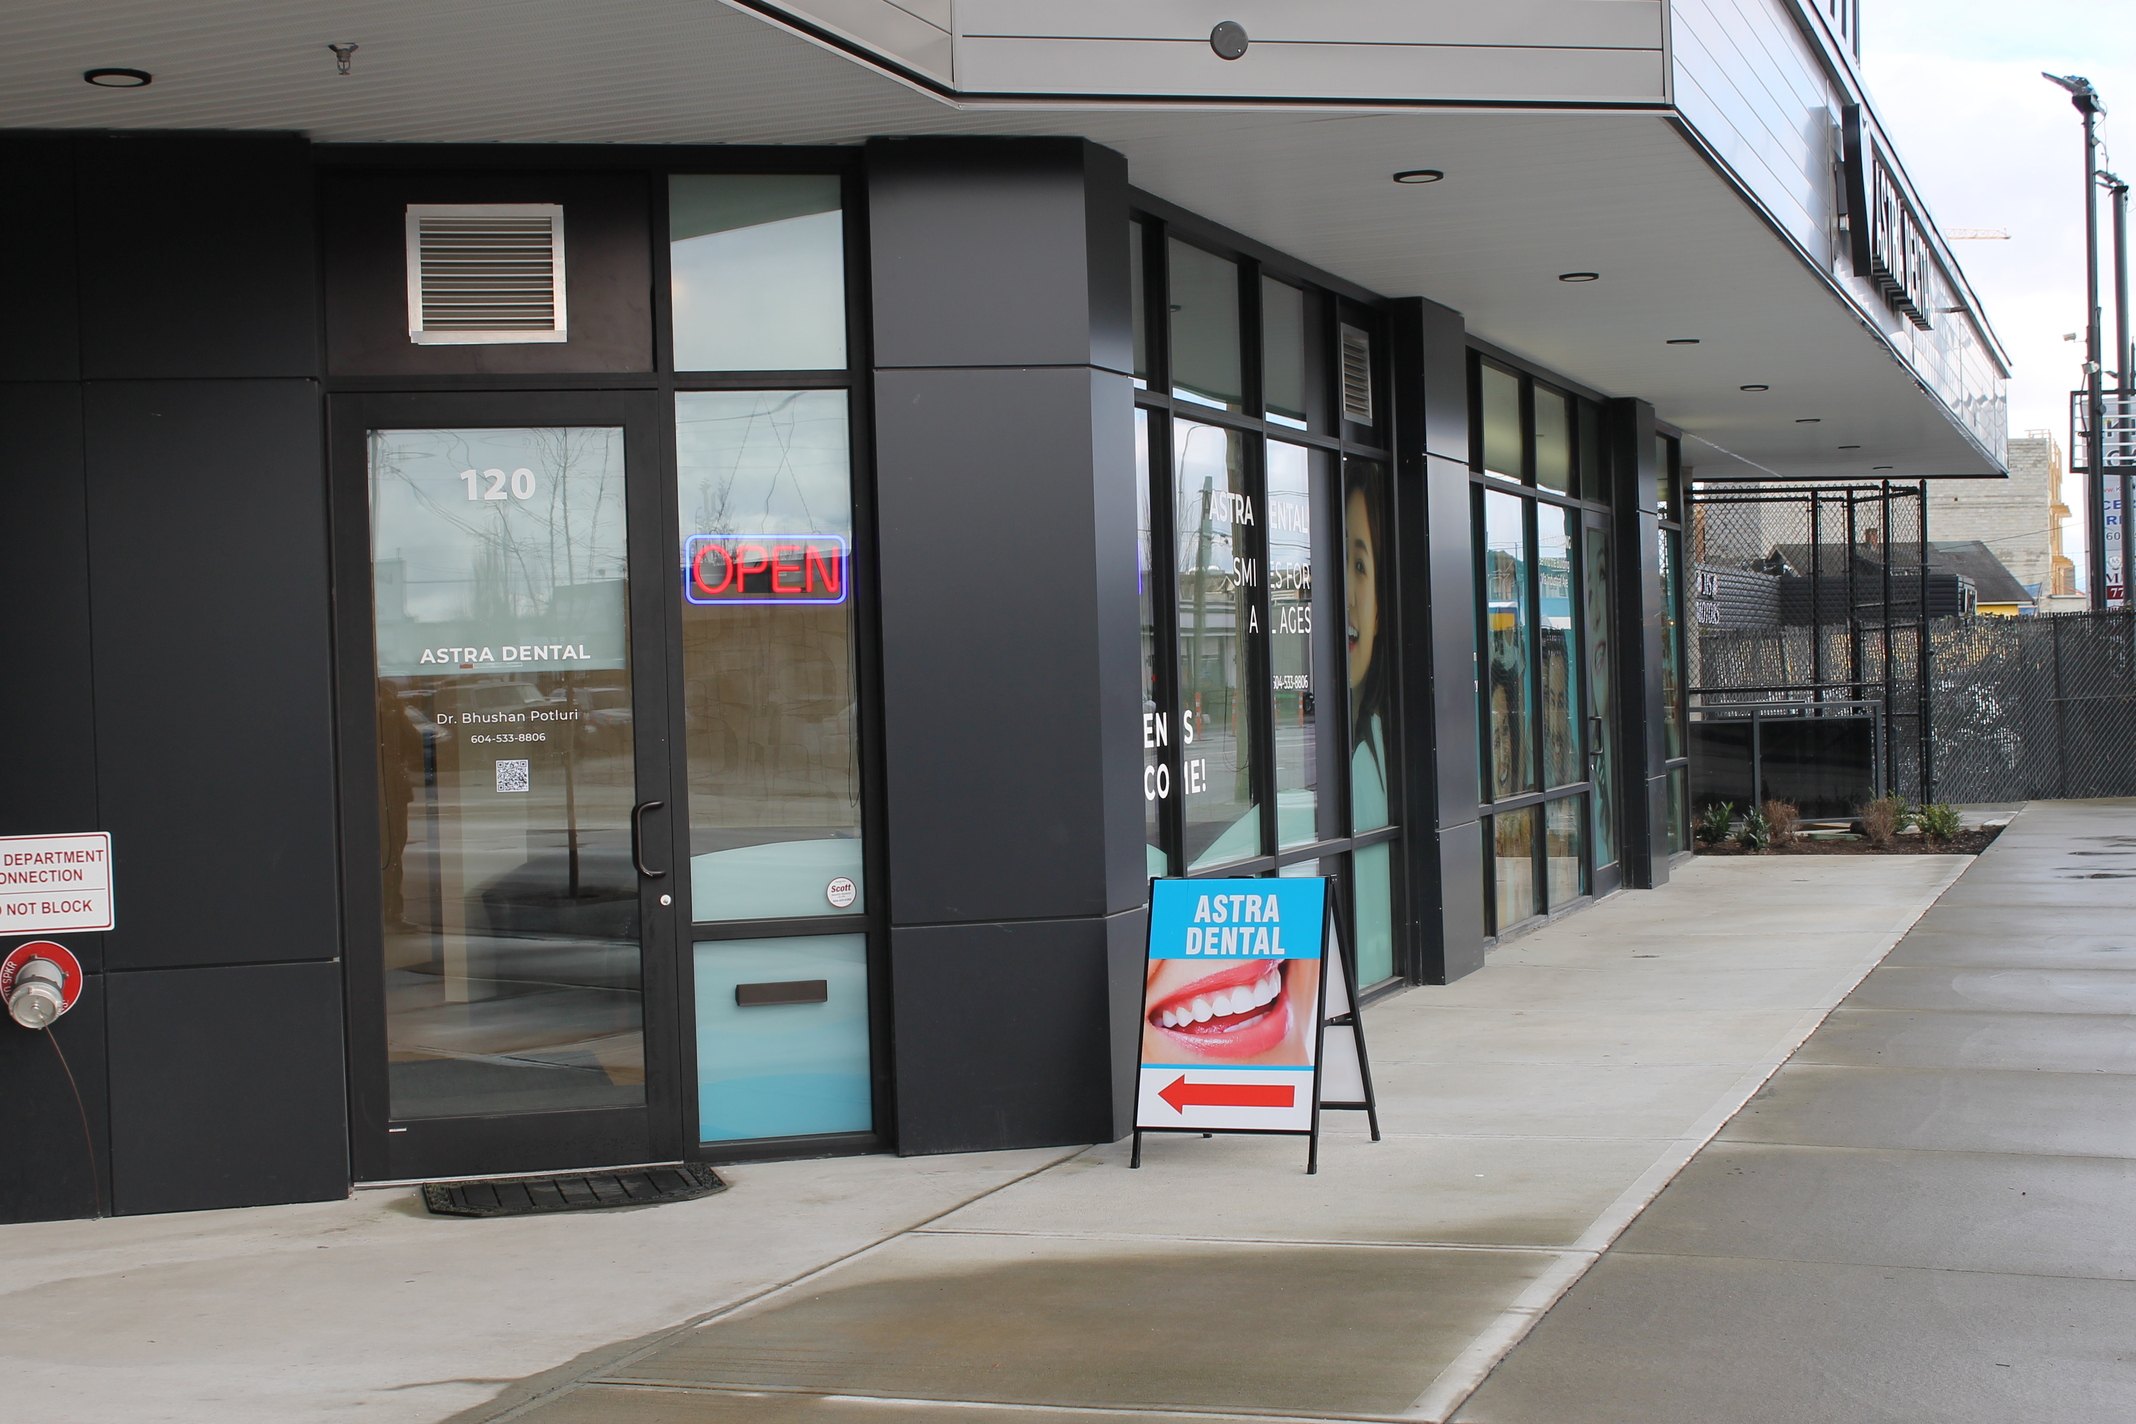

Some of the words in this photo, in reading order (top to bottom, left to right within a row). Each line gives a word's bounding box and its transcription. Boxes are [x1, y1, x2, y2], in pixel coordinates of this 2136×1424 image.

[460, 468, 536, 501] 120
[1209, 489, 1255, 527] ASTRA
[1269, 500, 1309, 534] ENTAL
[693, 544, 840, 594] OPEN
[1286, 562, 1311, 590] FOR
[1279, 606, 1311, 634] AGES
[420, 646, 495, 664] ASTRA
[502, 644, 591, 661] DENTAL
[436, 713, 457, 725] Dr.
[462, 711, 526, 724] Bhushan
[530, 708, 579, 722] Potluri
[470, 732, 546, 744] 604-533-8806
[3, 849, 104, 866] DEPARTMENT
[831, 884, 852, 893] Scott
[6, 902, 37, 916] NOT
[41, 899, 93, 914] BLOCK
[1193, 894, 1280, 924] ASTRA
[1185, 926, 1286, 956] DENTAL
[2, 960, 18, 984] SPKR
